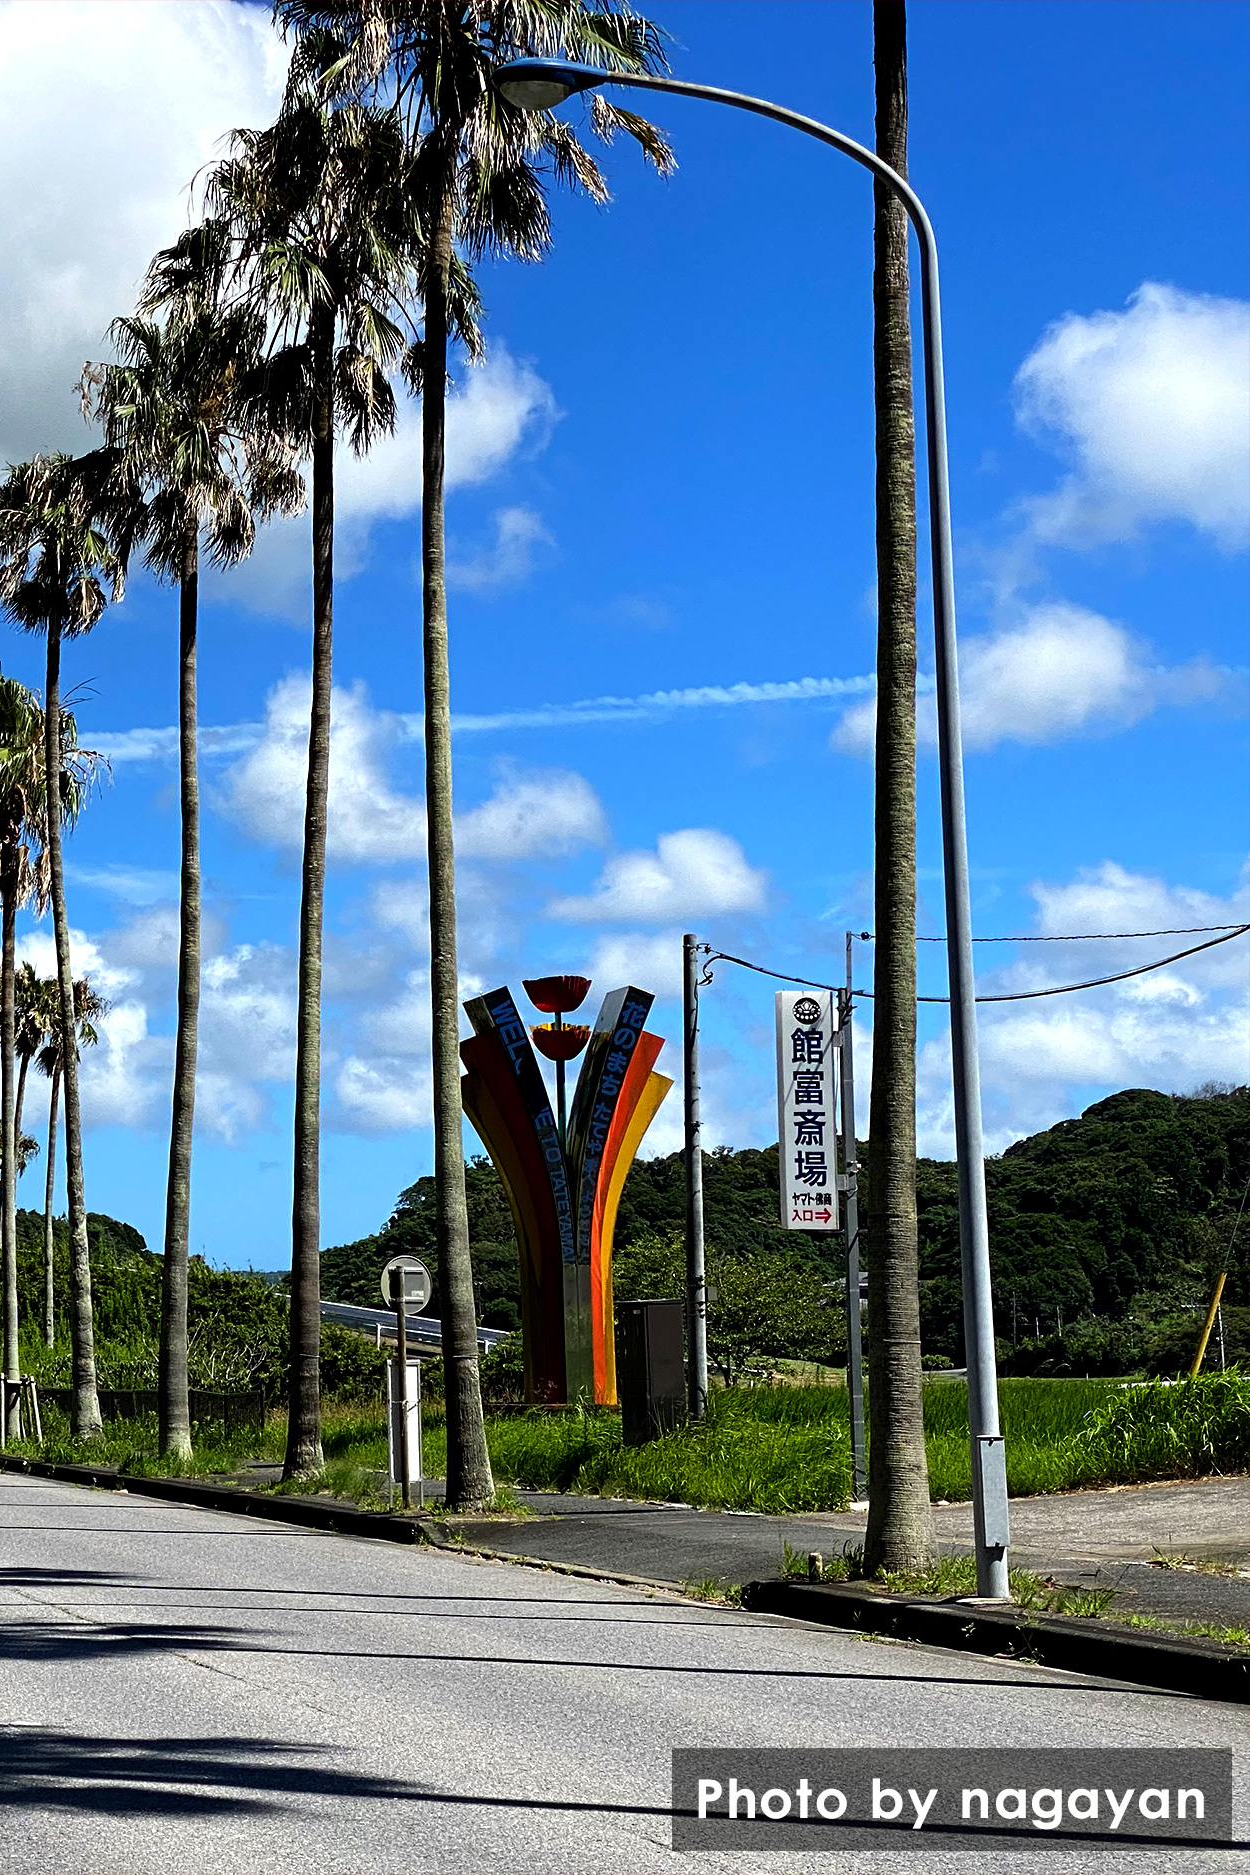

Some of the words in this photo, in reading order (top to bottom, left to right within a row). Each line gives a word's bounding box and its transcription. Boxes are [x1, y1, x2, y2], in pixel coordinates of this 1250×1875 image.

[601, 1000, 647, 1097] 花のまち
[790, 1028, 828, 1187] 館富斎場
[792, 1210, 813, 1222] 入口
